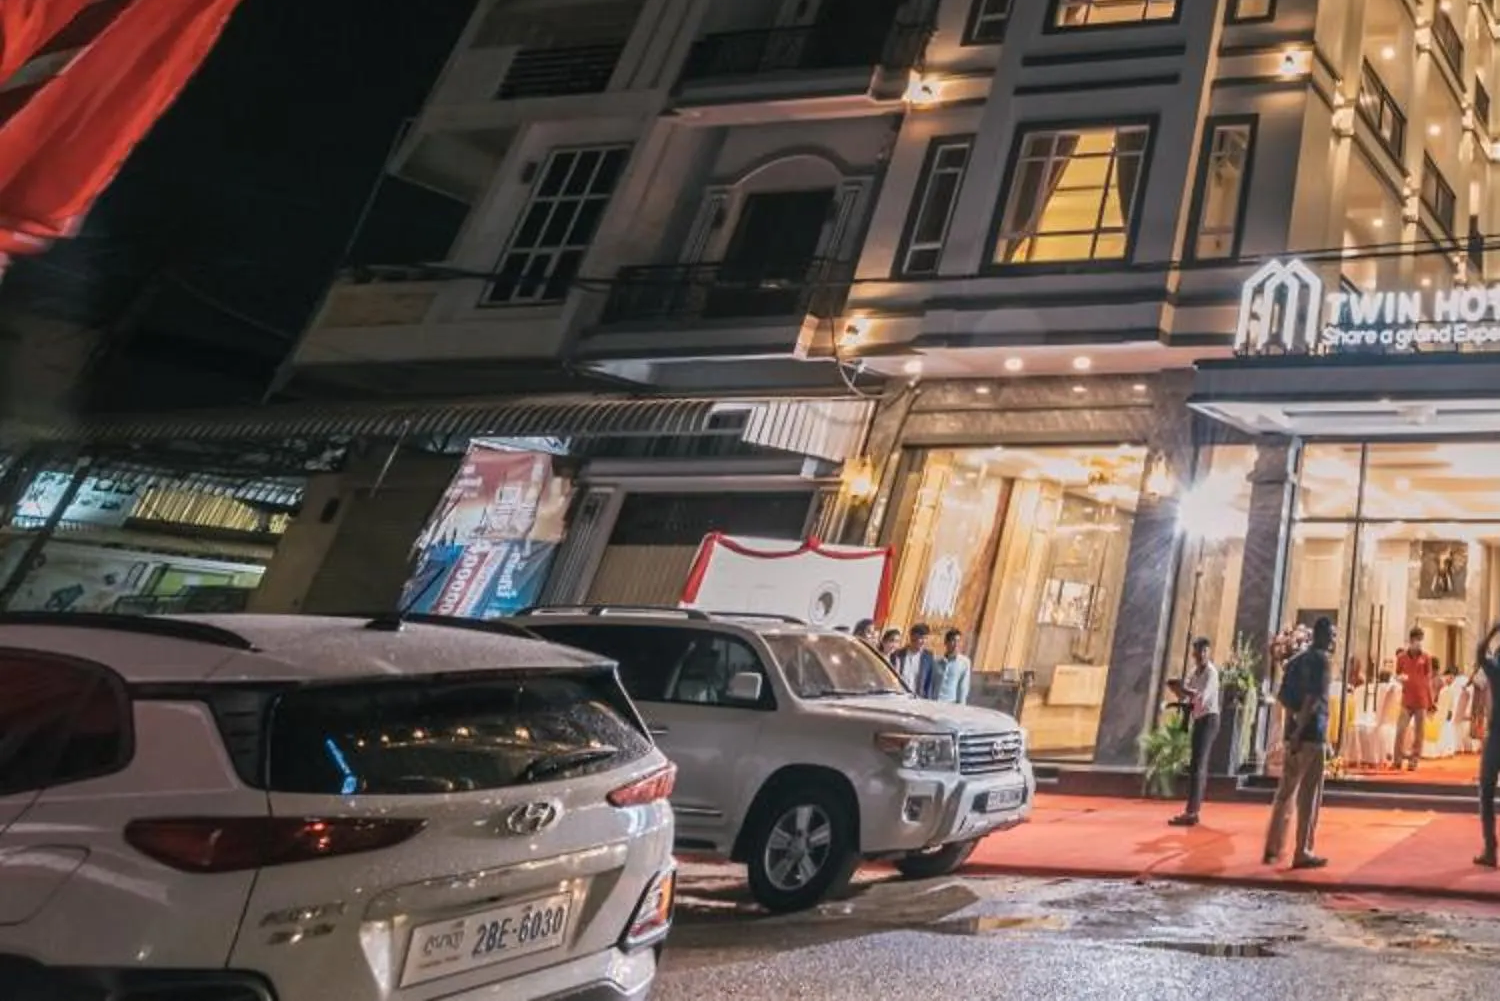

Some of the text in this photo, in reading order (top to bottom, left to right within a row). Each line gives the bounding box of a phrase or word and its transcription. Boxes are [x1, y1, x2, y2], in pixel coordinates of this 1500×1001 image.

[1325, 291, 1421, 325] TWIN
[1322, 326, 1377, 347] Share
[1380, 328, 1393, 344] a
[1396, 326, 1450, 349] grand
[472, 905, 565, 957] 2BE-6030
